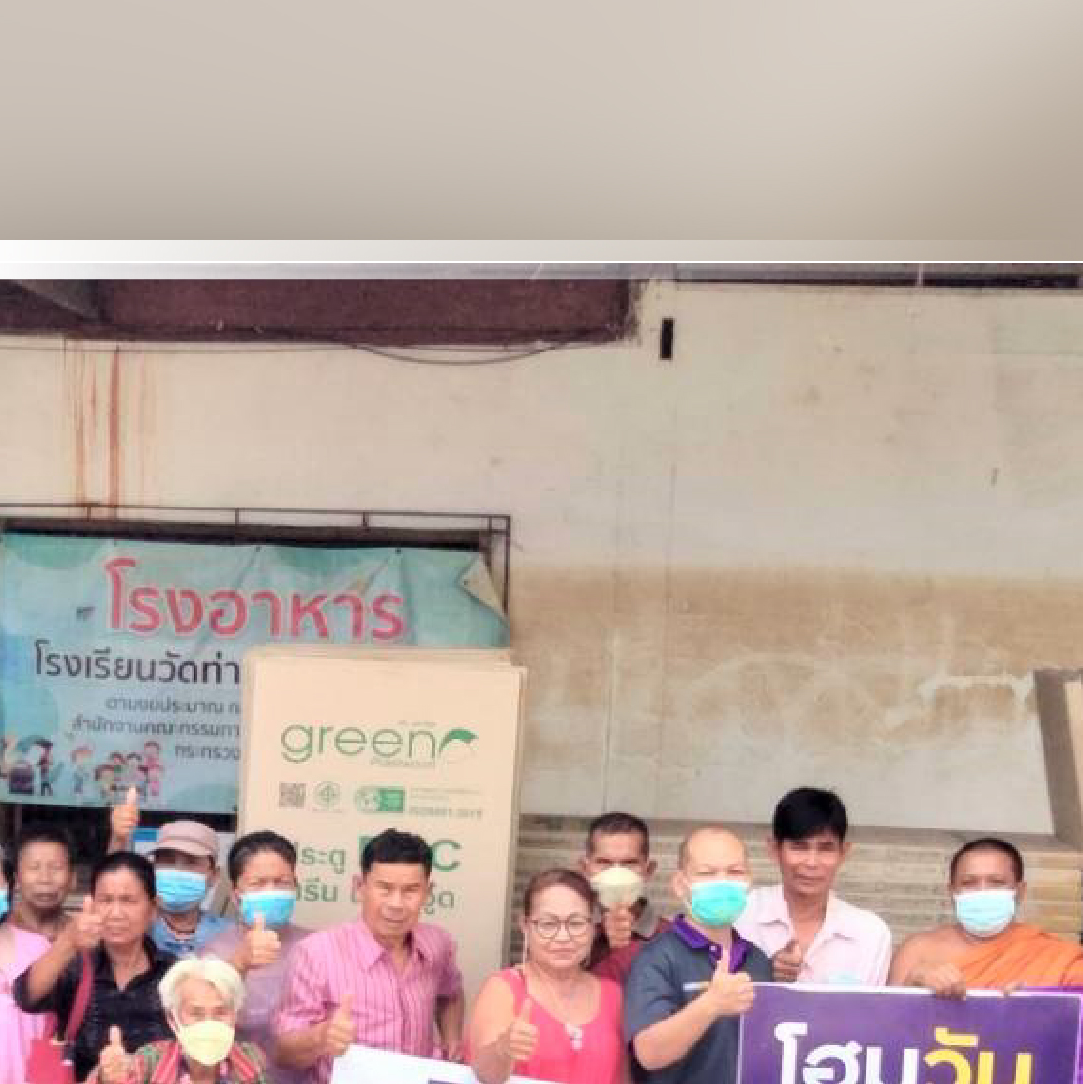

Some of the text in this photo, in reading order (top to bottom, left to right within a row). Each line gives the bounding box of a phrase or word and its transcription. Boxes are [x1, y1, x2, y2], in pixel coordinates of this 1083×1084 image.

[103, 557, 404, 641] โรงอาหาร
[35, 641, 241, 685] โรงเรียนวัดท่า
[280, 724, 436, 763] green
